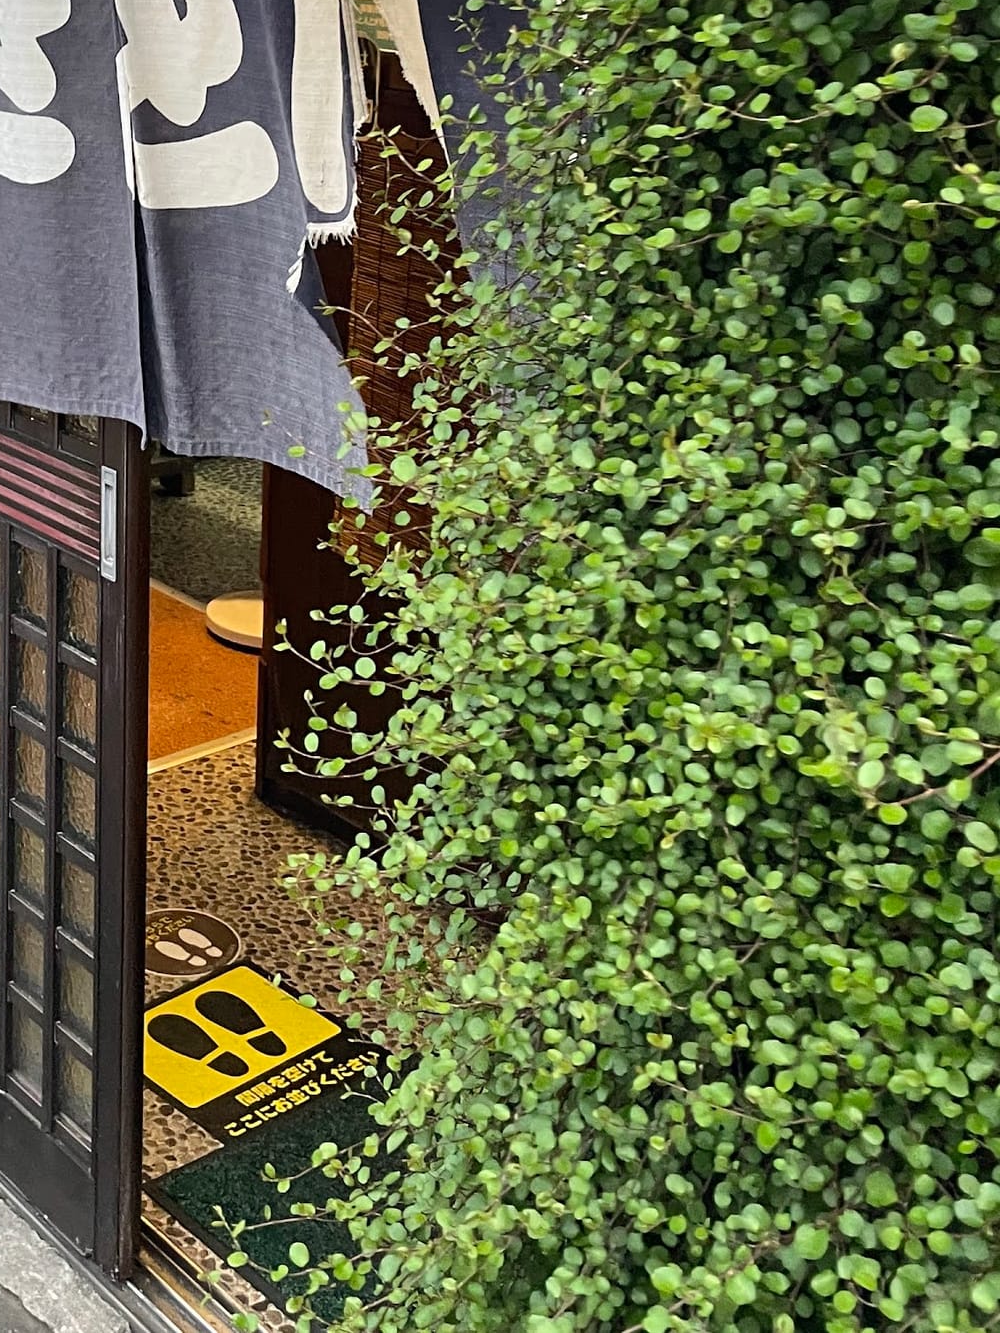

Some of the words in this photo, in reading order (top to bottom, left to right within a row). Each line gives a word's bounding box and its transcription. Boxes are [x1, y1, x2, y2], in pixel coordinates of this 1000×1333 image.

[223, 1051, 381, 1137] ここにお並びください
[234, 1050, 334, 1107] 間隔を空けて
